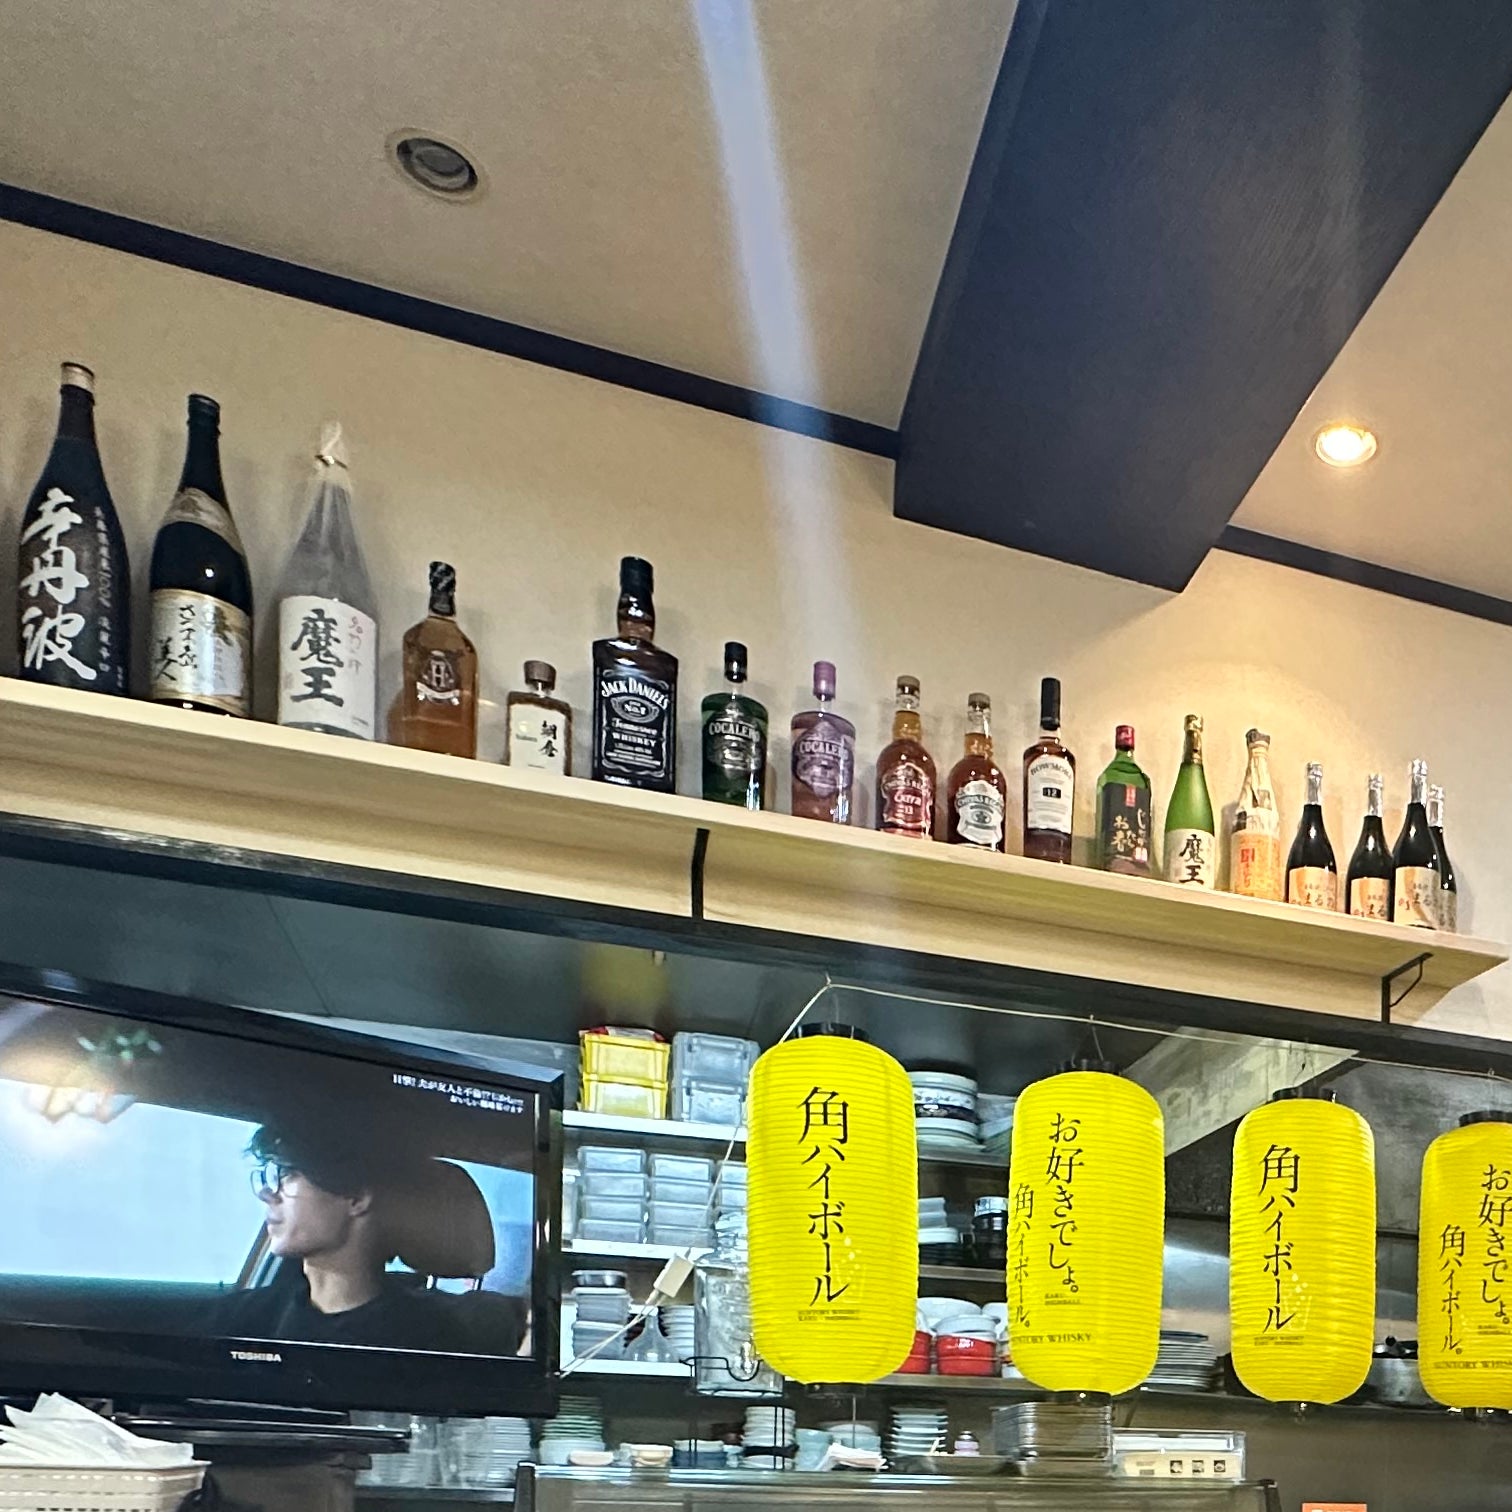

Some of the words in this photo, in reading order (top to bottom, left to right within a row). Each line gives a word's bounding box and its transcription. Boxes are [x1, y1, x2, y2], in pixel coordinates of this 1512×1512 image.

[20, 487, 97, 680] 辛丹波
[290, 609, 344, 708] 魔王
[601, 681, 628, 697] JACK
[628, 677, 669, 710] DANIEL'S
[1179, 834, 1204, 885] 魔王
[799, 1086, 849, 1307] 角ハイボール
[1014, 1183, 1034, 1328] 角ハイボール。
[1046, 1113, 1085, 1293] お好きでしょ。
[1259, 1143, 1300, 1334] 角ハイボール
[1046, 1332, 1092, 1343] WHISKY
[1439, 1224, 1465, 1355] 角ハイボール。
[230, 1351, 282, 1362] TOSHIBA
